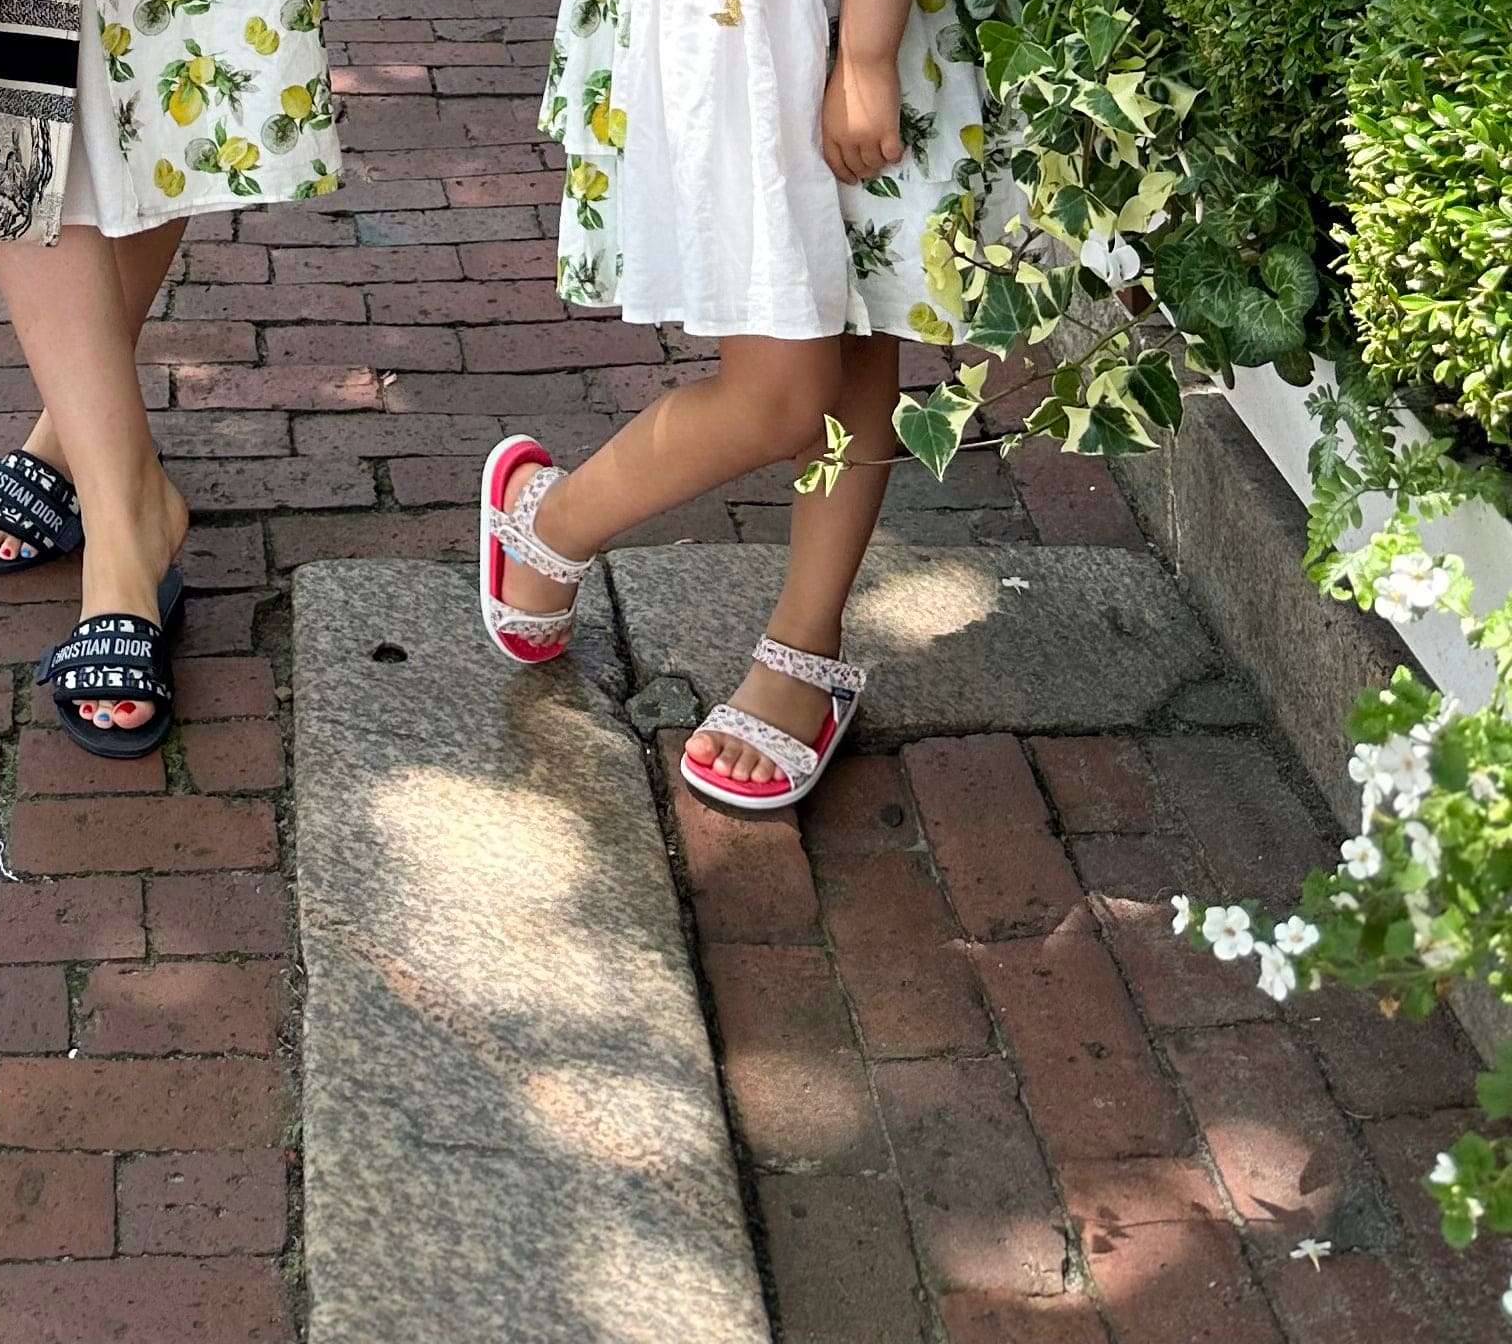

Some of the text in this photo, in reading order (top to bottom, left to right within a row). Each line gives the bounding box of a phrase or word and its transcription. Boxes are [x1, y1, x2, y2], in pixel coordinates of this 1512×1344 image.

[30, 499, 63, 533] DIOR
[51, 638, 152, 668] CHRISTIAN DIOR
